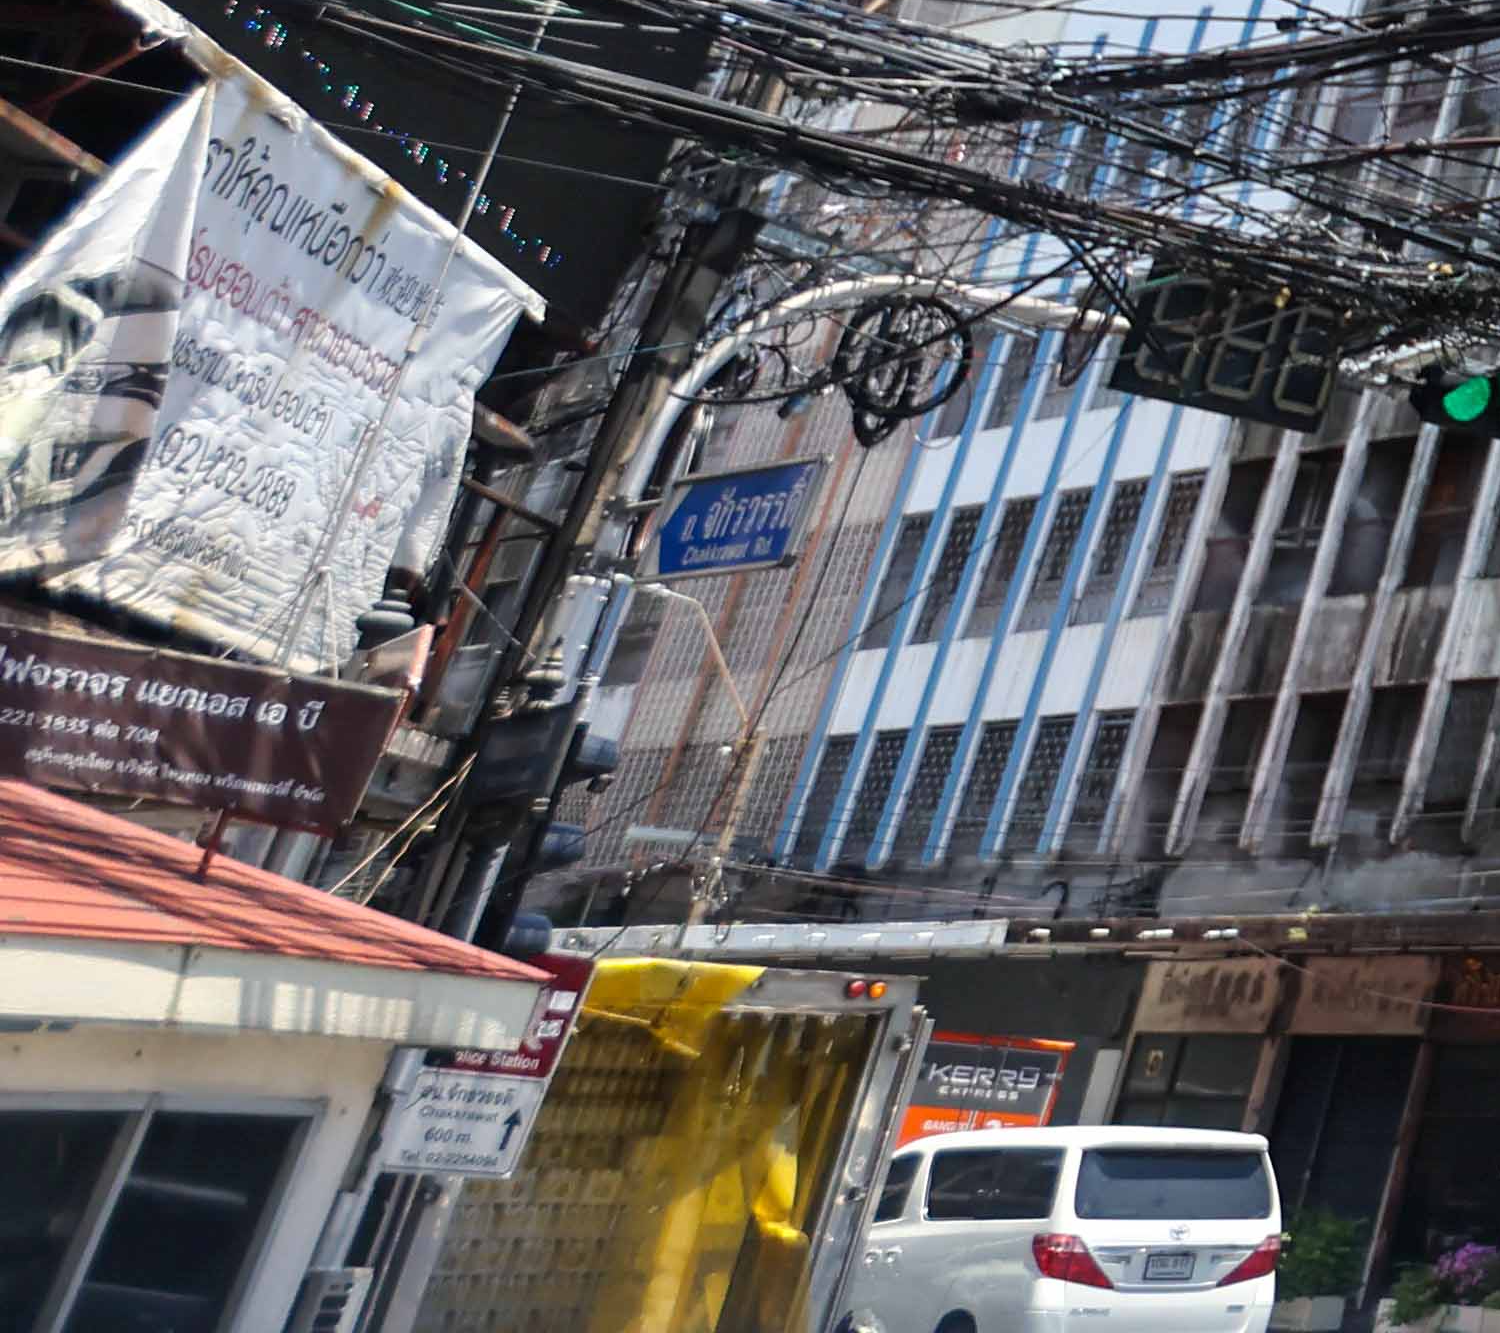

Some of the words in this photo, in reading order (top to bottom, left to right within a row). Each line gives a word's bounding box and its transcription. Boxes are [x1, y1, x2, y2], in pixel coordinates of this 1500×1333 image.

[203, 137, 386, 294] ราให้คุณเหนือกว่า
[135, 678, 250, 719] แยกเอส
[254, 700, 289, 727] เอ
[298, 700, 327, 731] บี
[490, 1051, 541, 1070] Station
[927, 1062, 1041, 1091] KERRY
[937, 1085, 1021, 1102] EXPRESS
[424, 1126, 454, 1143] 600
